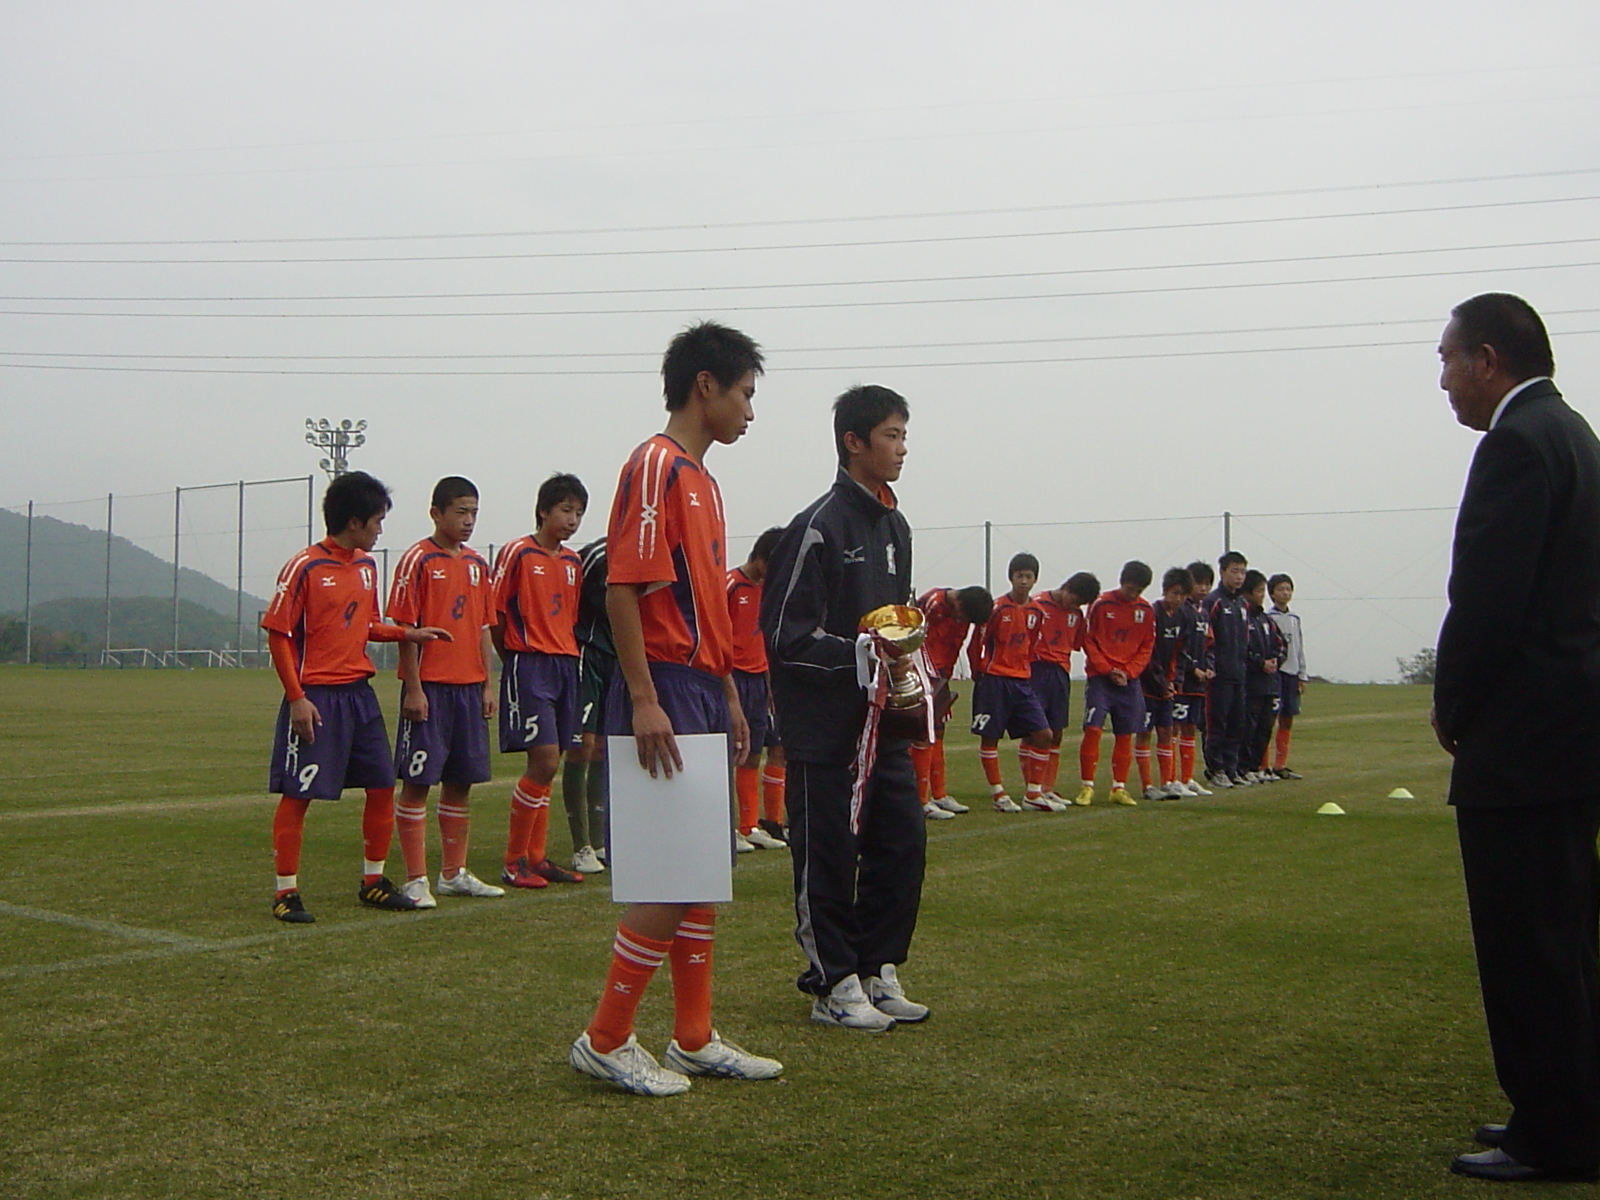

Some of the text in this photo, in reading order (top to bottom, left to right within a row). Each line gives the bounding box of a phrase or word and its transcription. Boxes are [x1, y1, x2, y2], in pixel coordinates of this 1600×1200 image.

[343, 601, 358, 628] 9
[451, 595, 466, 619] 8
[550, 594, 562, 616] 5
[1049, 630, 1062, 646] 2
[582, 702, 593, 724] 1
[972, 713, 991, 730] 19
[1172, 703, 1189, 719] 25
[524, 714, 539, 742] 5
[409, 751, 427, 777] 8
[299, 764, 319, 792] 9
